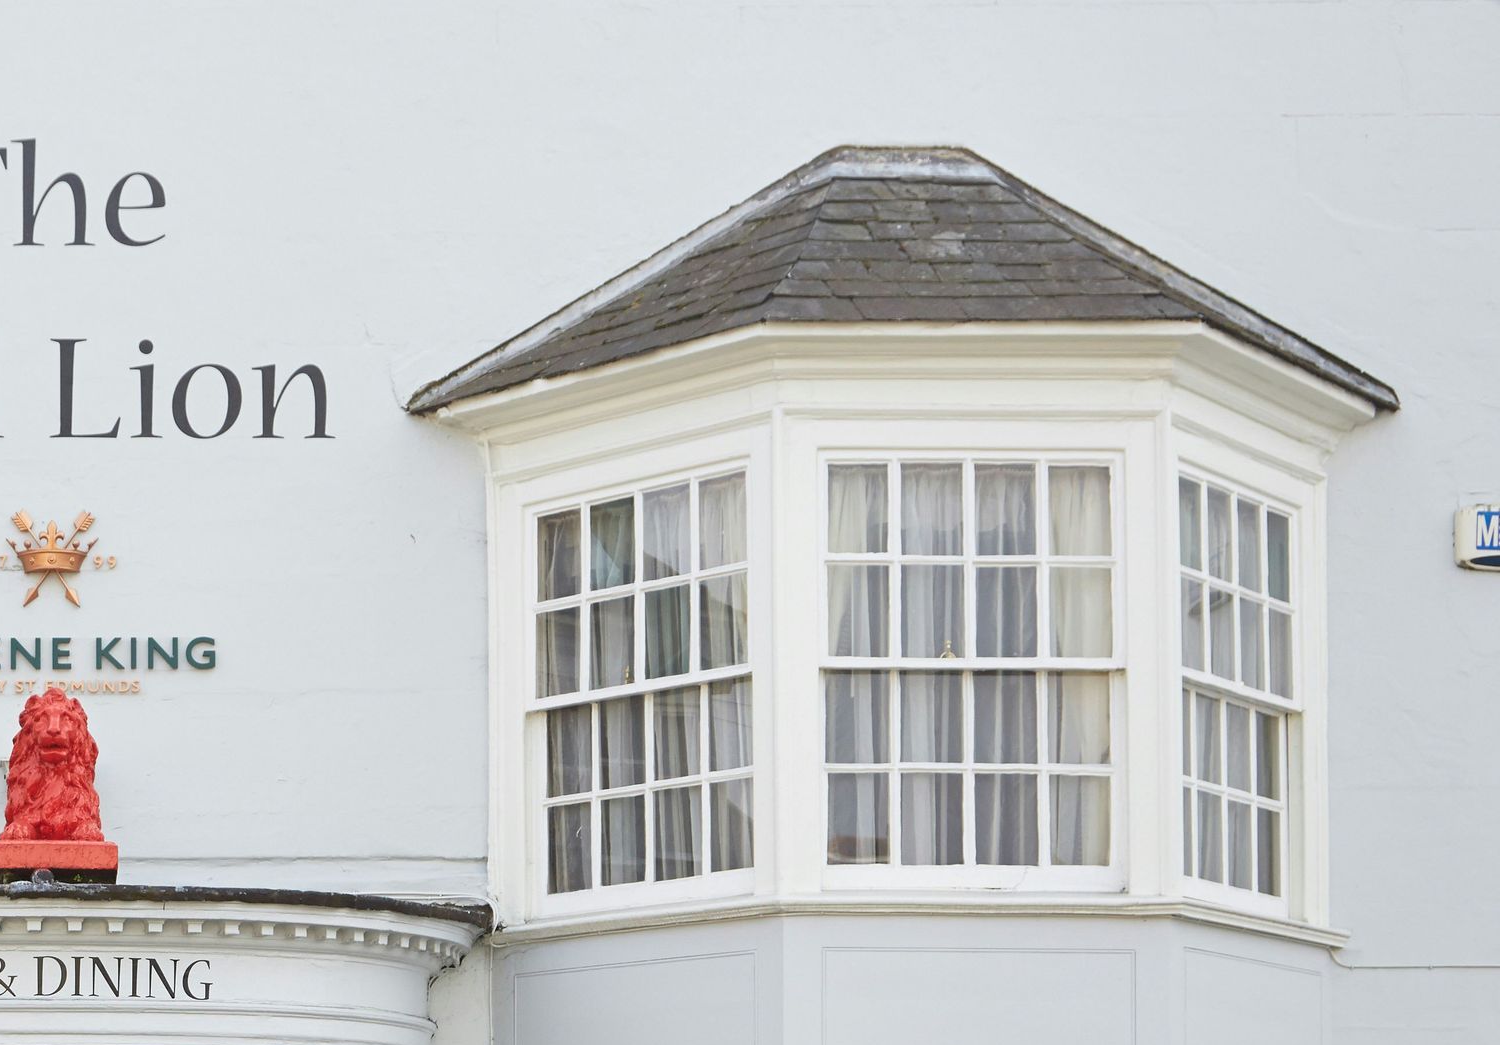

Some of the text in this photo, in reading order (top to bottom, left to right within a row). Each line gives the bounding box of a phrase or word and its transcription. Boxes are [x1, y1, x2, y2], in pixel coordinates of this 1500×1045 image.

[49, 338, 336, 439] Lion
[95, 636, 216, 670] KING
[14, 680, 36, 693] ST
[33, 956, 214, 1001] DINING
